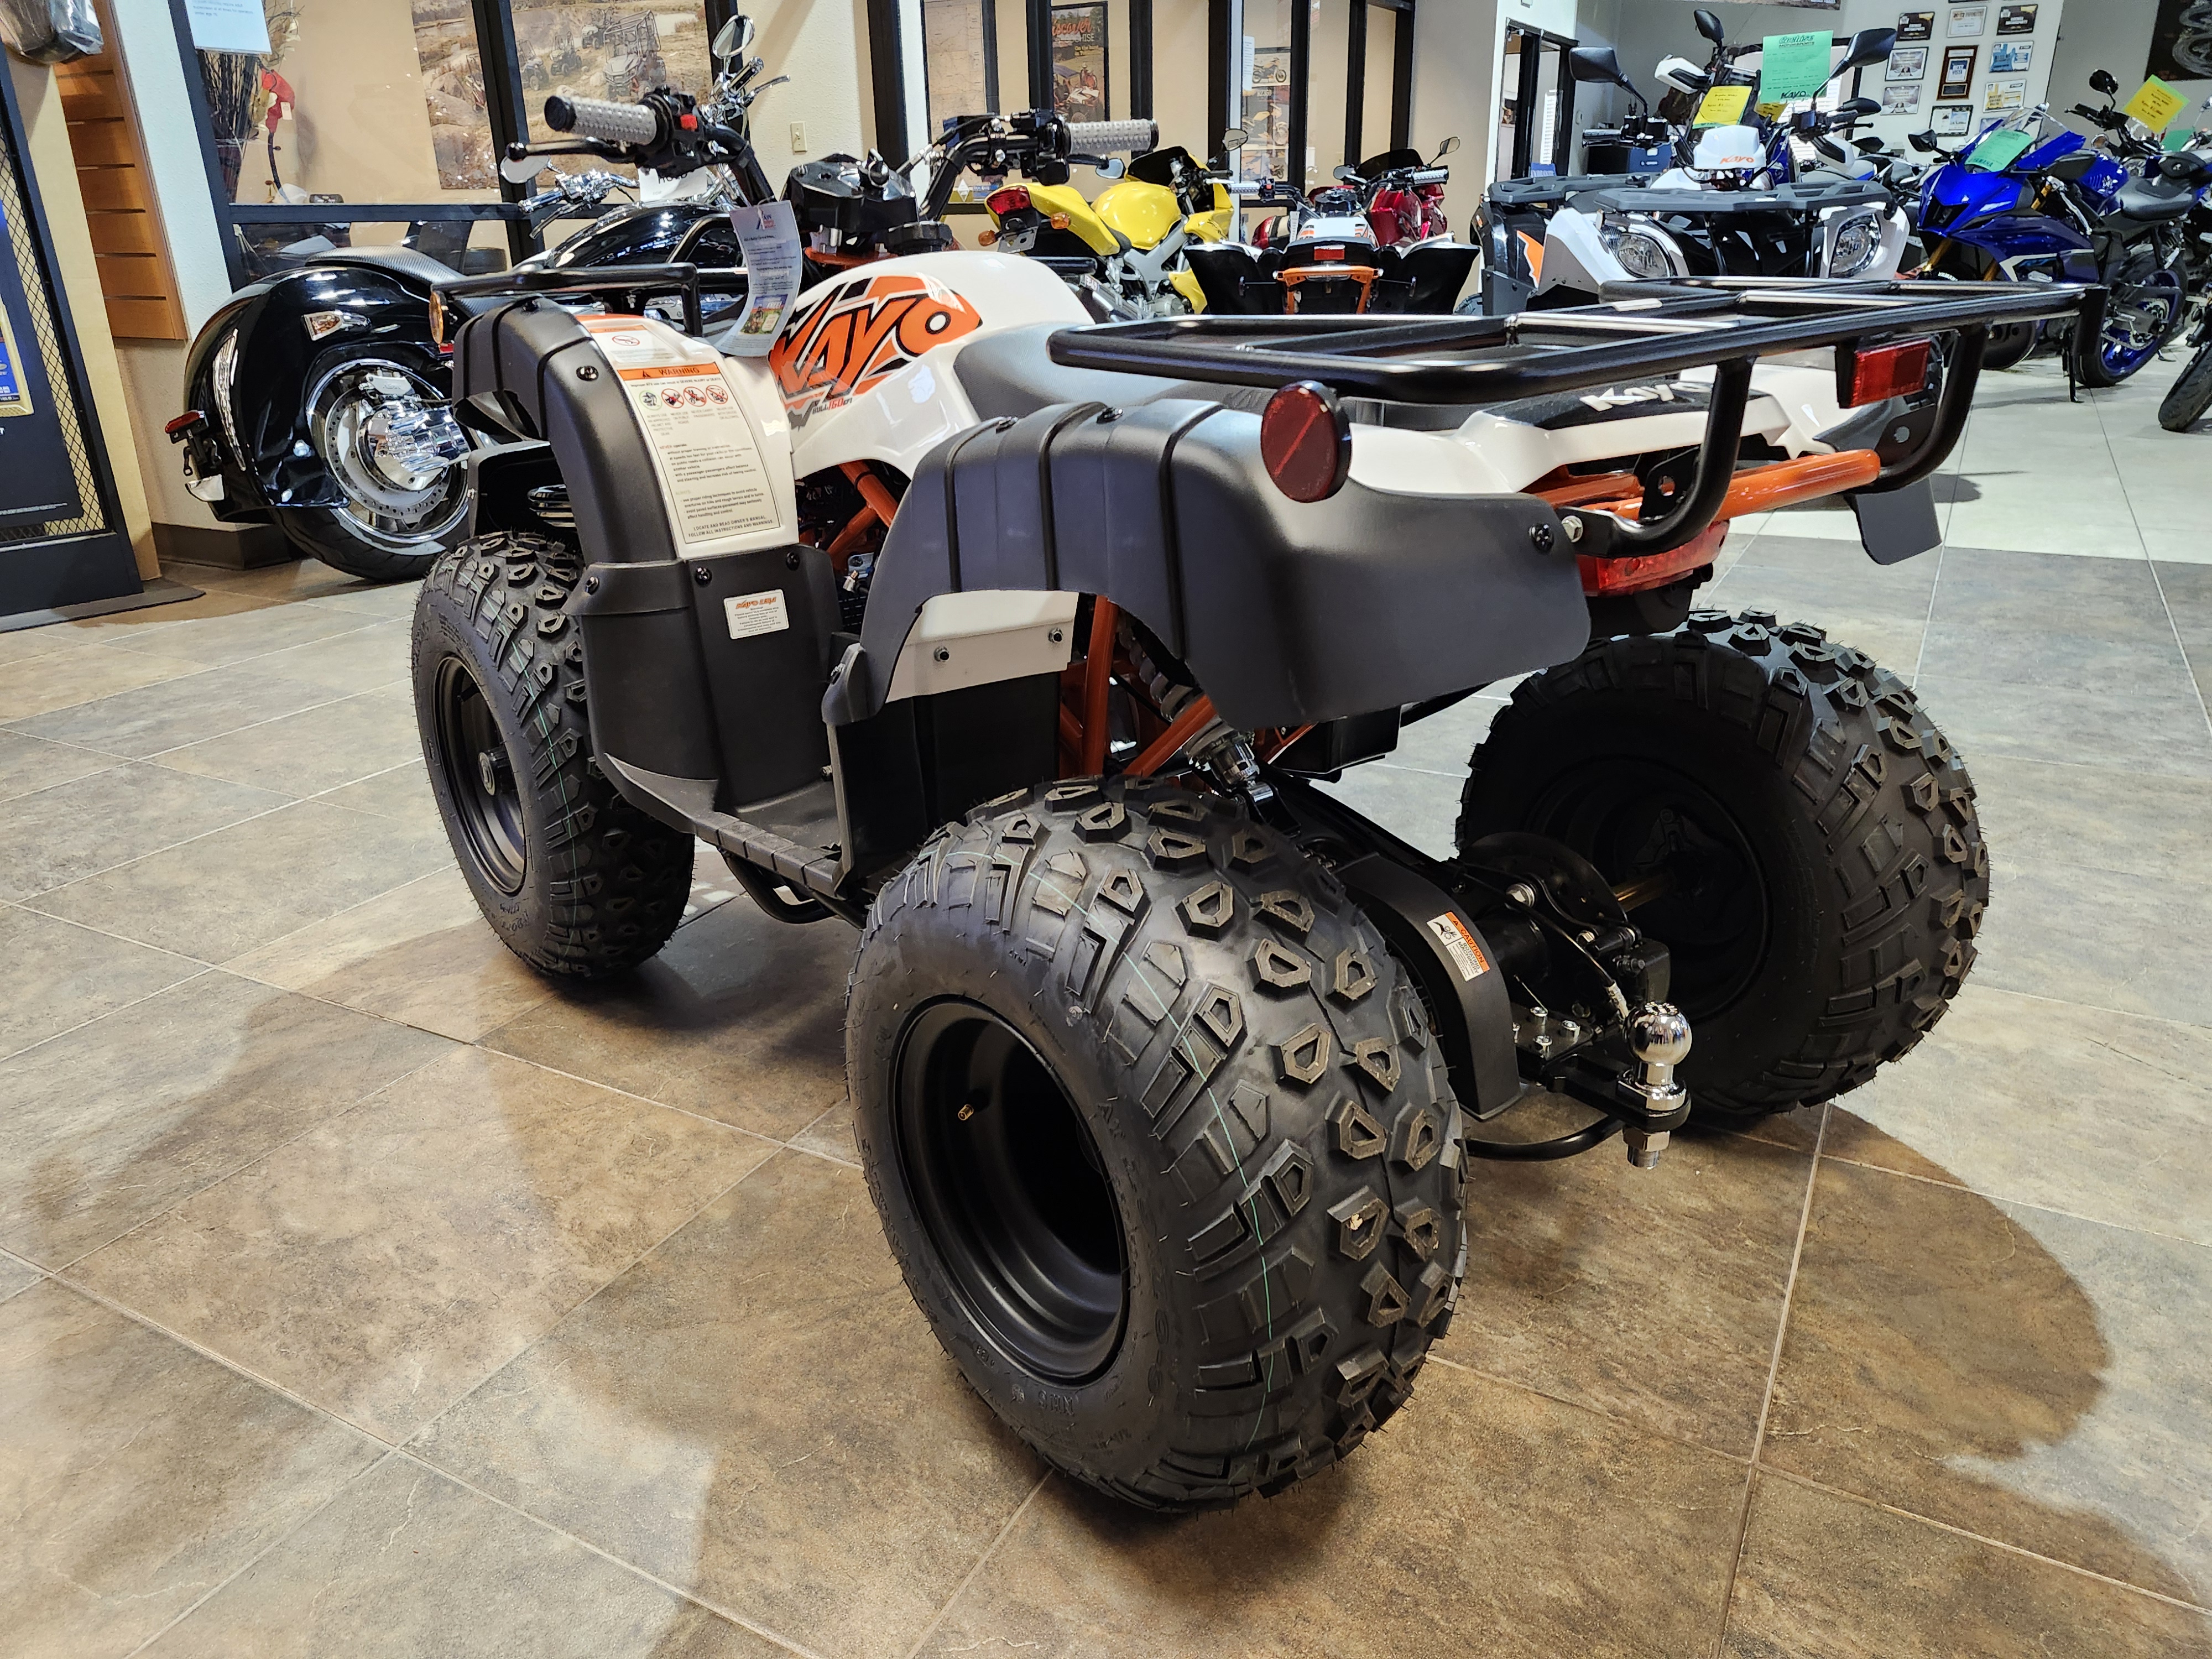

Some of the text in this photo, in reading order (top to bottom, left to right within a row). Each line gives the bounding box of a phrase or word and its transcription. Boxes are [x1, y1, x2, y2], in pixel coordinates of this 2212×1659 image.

[1052, 18, 1092, 36] iscover
[1719, 154, 1755, 164] KAYO
[768, 279, 983, 398] KAYO
[659, 367, 700, 376] WARNING
[713, 524, 742, 533] INSTRUCTIONS
[1460, 929, 1484, 963] CAUTION
[1463, 942, 1480, 969] ROTATING
[1457, 941, 1479, 974] MACHINERY
